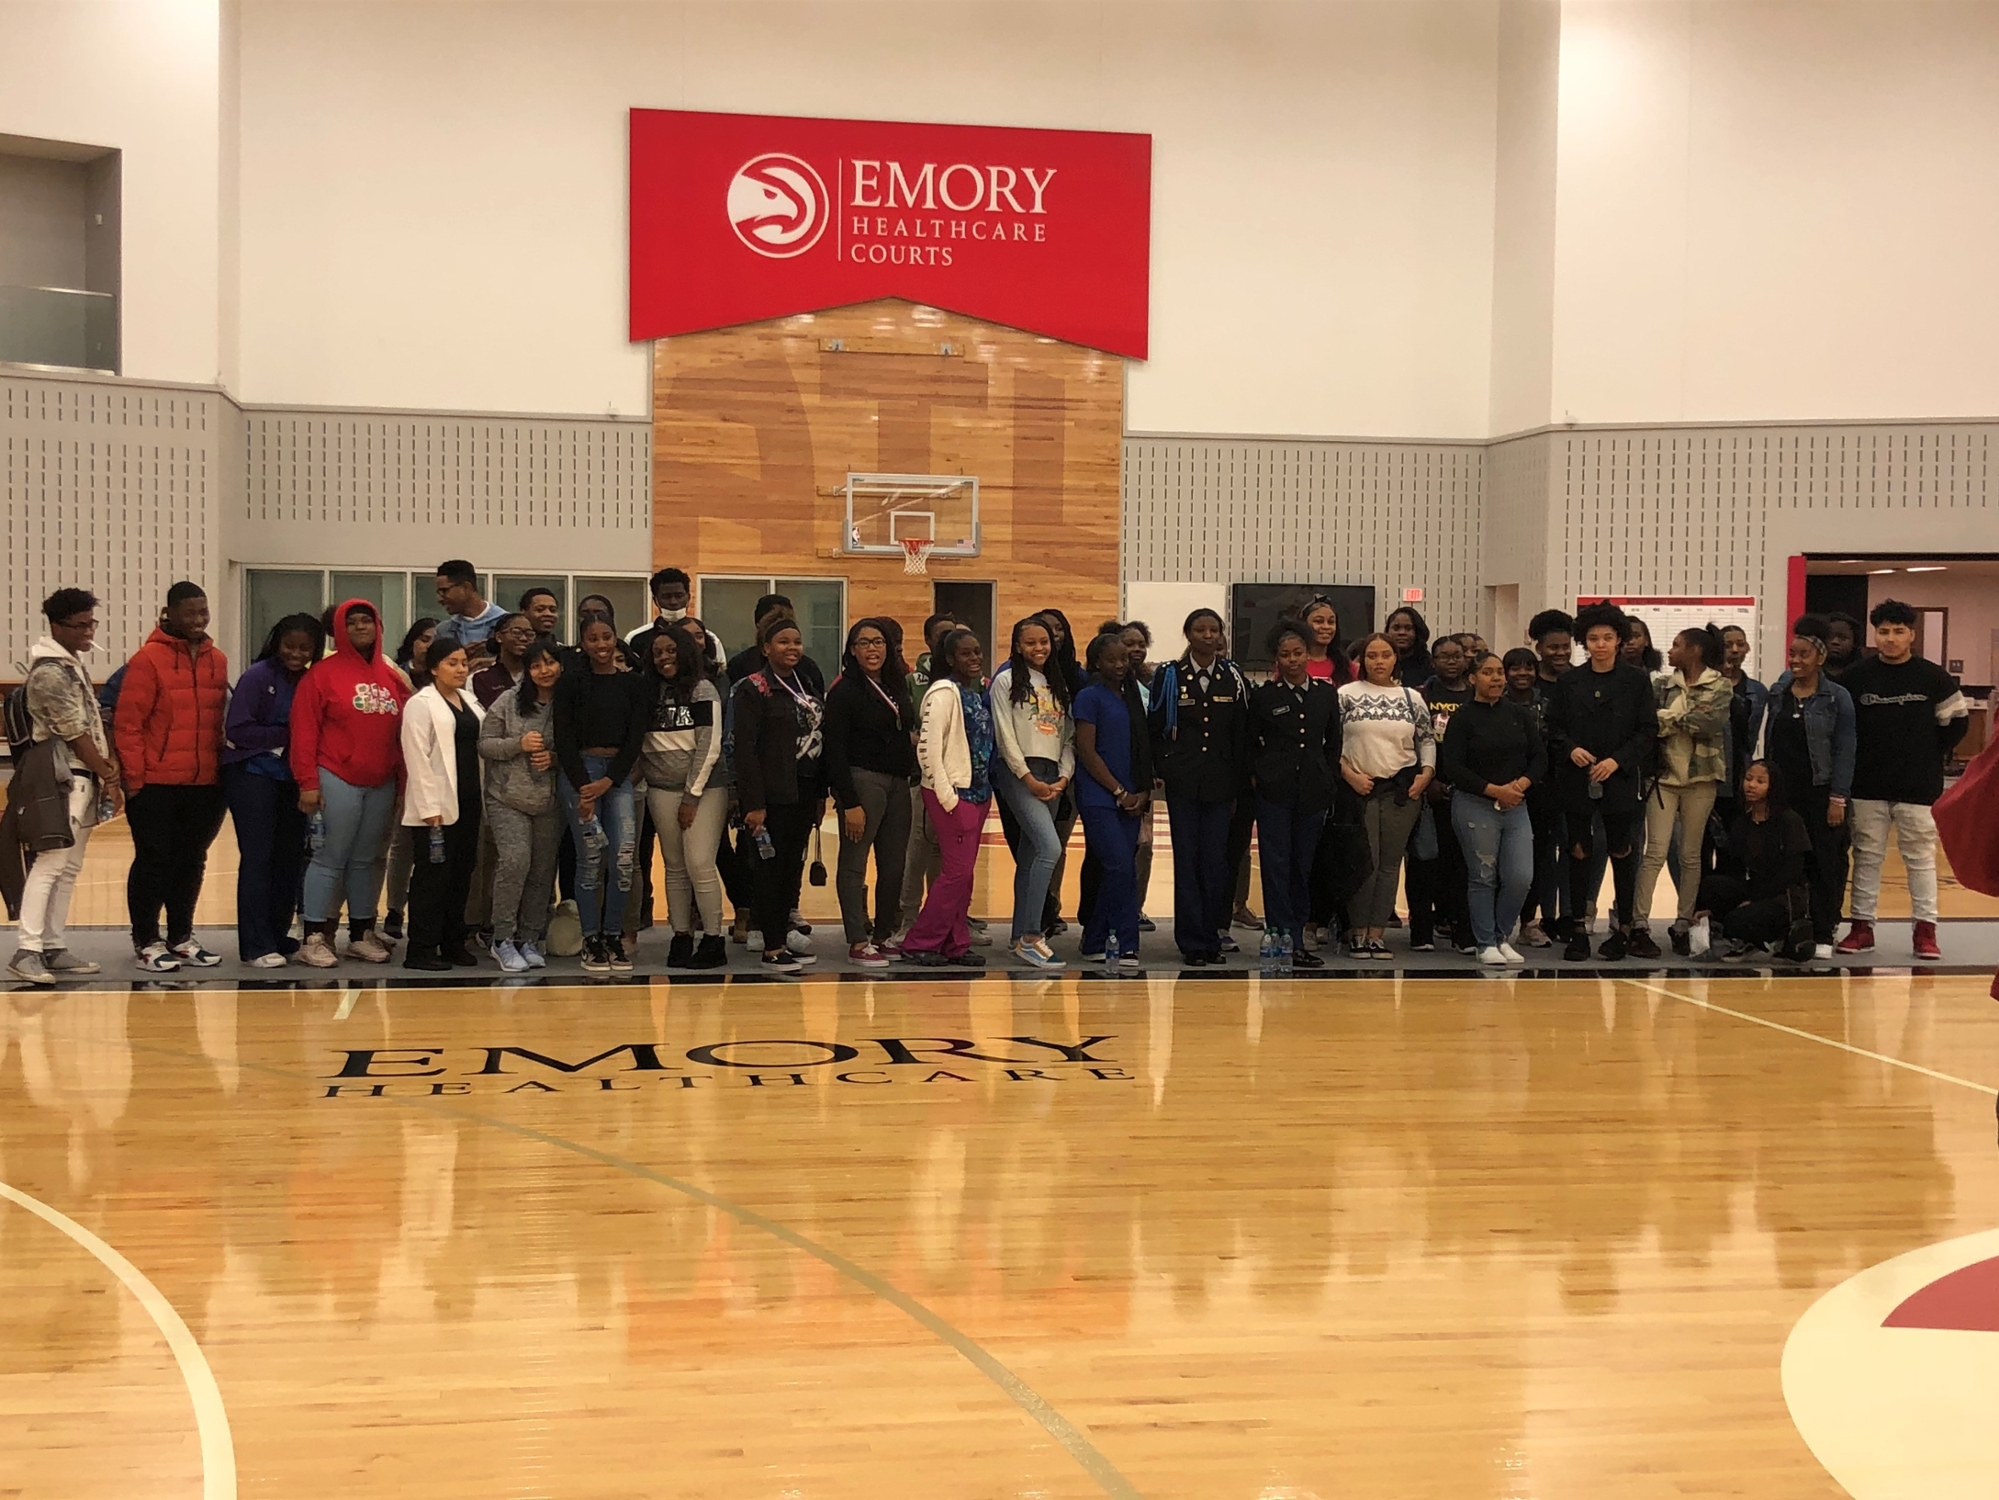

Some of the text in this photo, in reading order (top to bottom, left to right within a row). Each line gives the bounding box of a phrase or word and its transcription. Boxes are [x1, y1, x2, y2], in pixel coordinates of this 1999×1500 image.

[851, 158, 1057, 214] EMORY
[852, 216, 1046, 242] HEALTHCARE
[851, 244, 953, 266] COURTS
[1859, 692, 1928, 706] Champion
[316, 1035, 1119, 1078] EMORY
[316, 1067, 1136, 1098] HEALTHCARE
